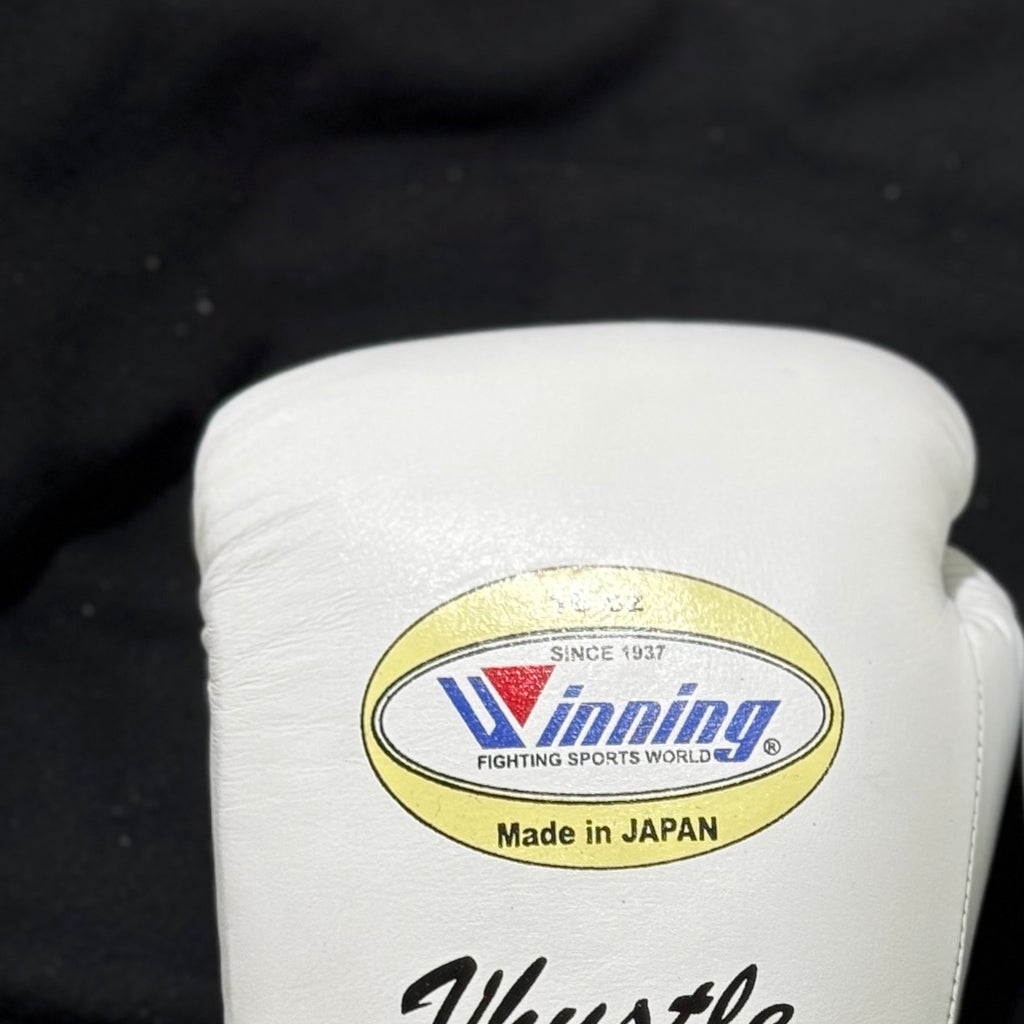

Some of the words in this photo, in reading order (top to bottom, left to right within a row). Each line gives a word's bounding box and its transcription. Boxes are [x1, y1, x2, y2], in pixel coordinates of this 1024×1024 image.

[550, 644, 614, 663] SINCE
[623, 645, 667, 662] 1937
[437, 664, 782, 764] Winning
[477, 750, 562, 770] FIGHTING
[567, 750, 641, 767] SPORTS
[645, 749, 714, 765] WORLD
[497, 820, 576, 848] Made
[586, 819, 612, 845] in
[622, 816, 718, 844] JAPAN
